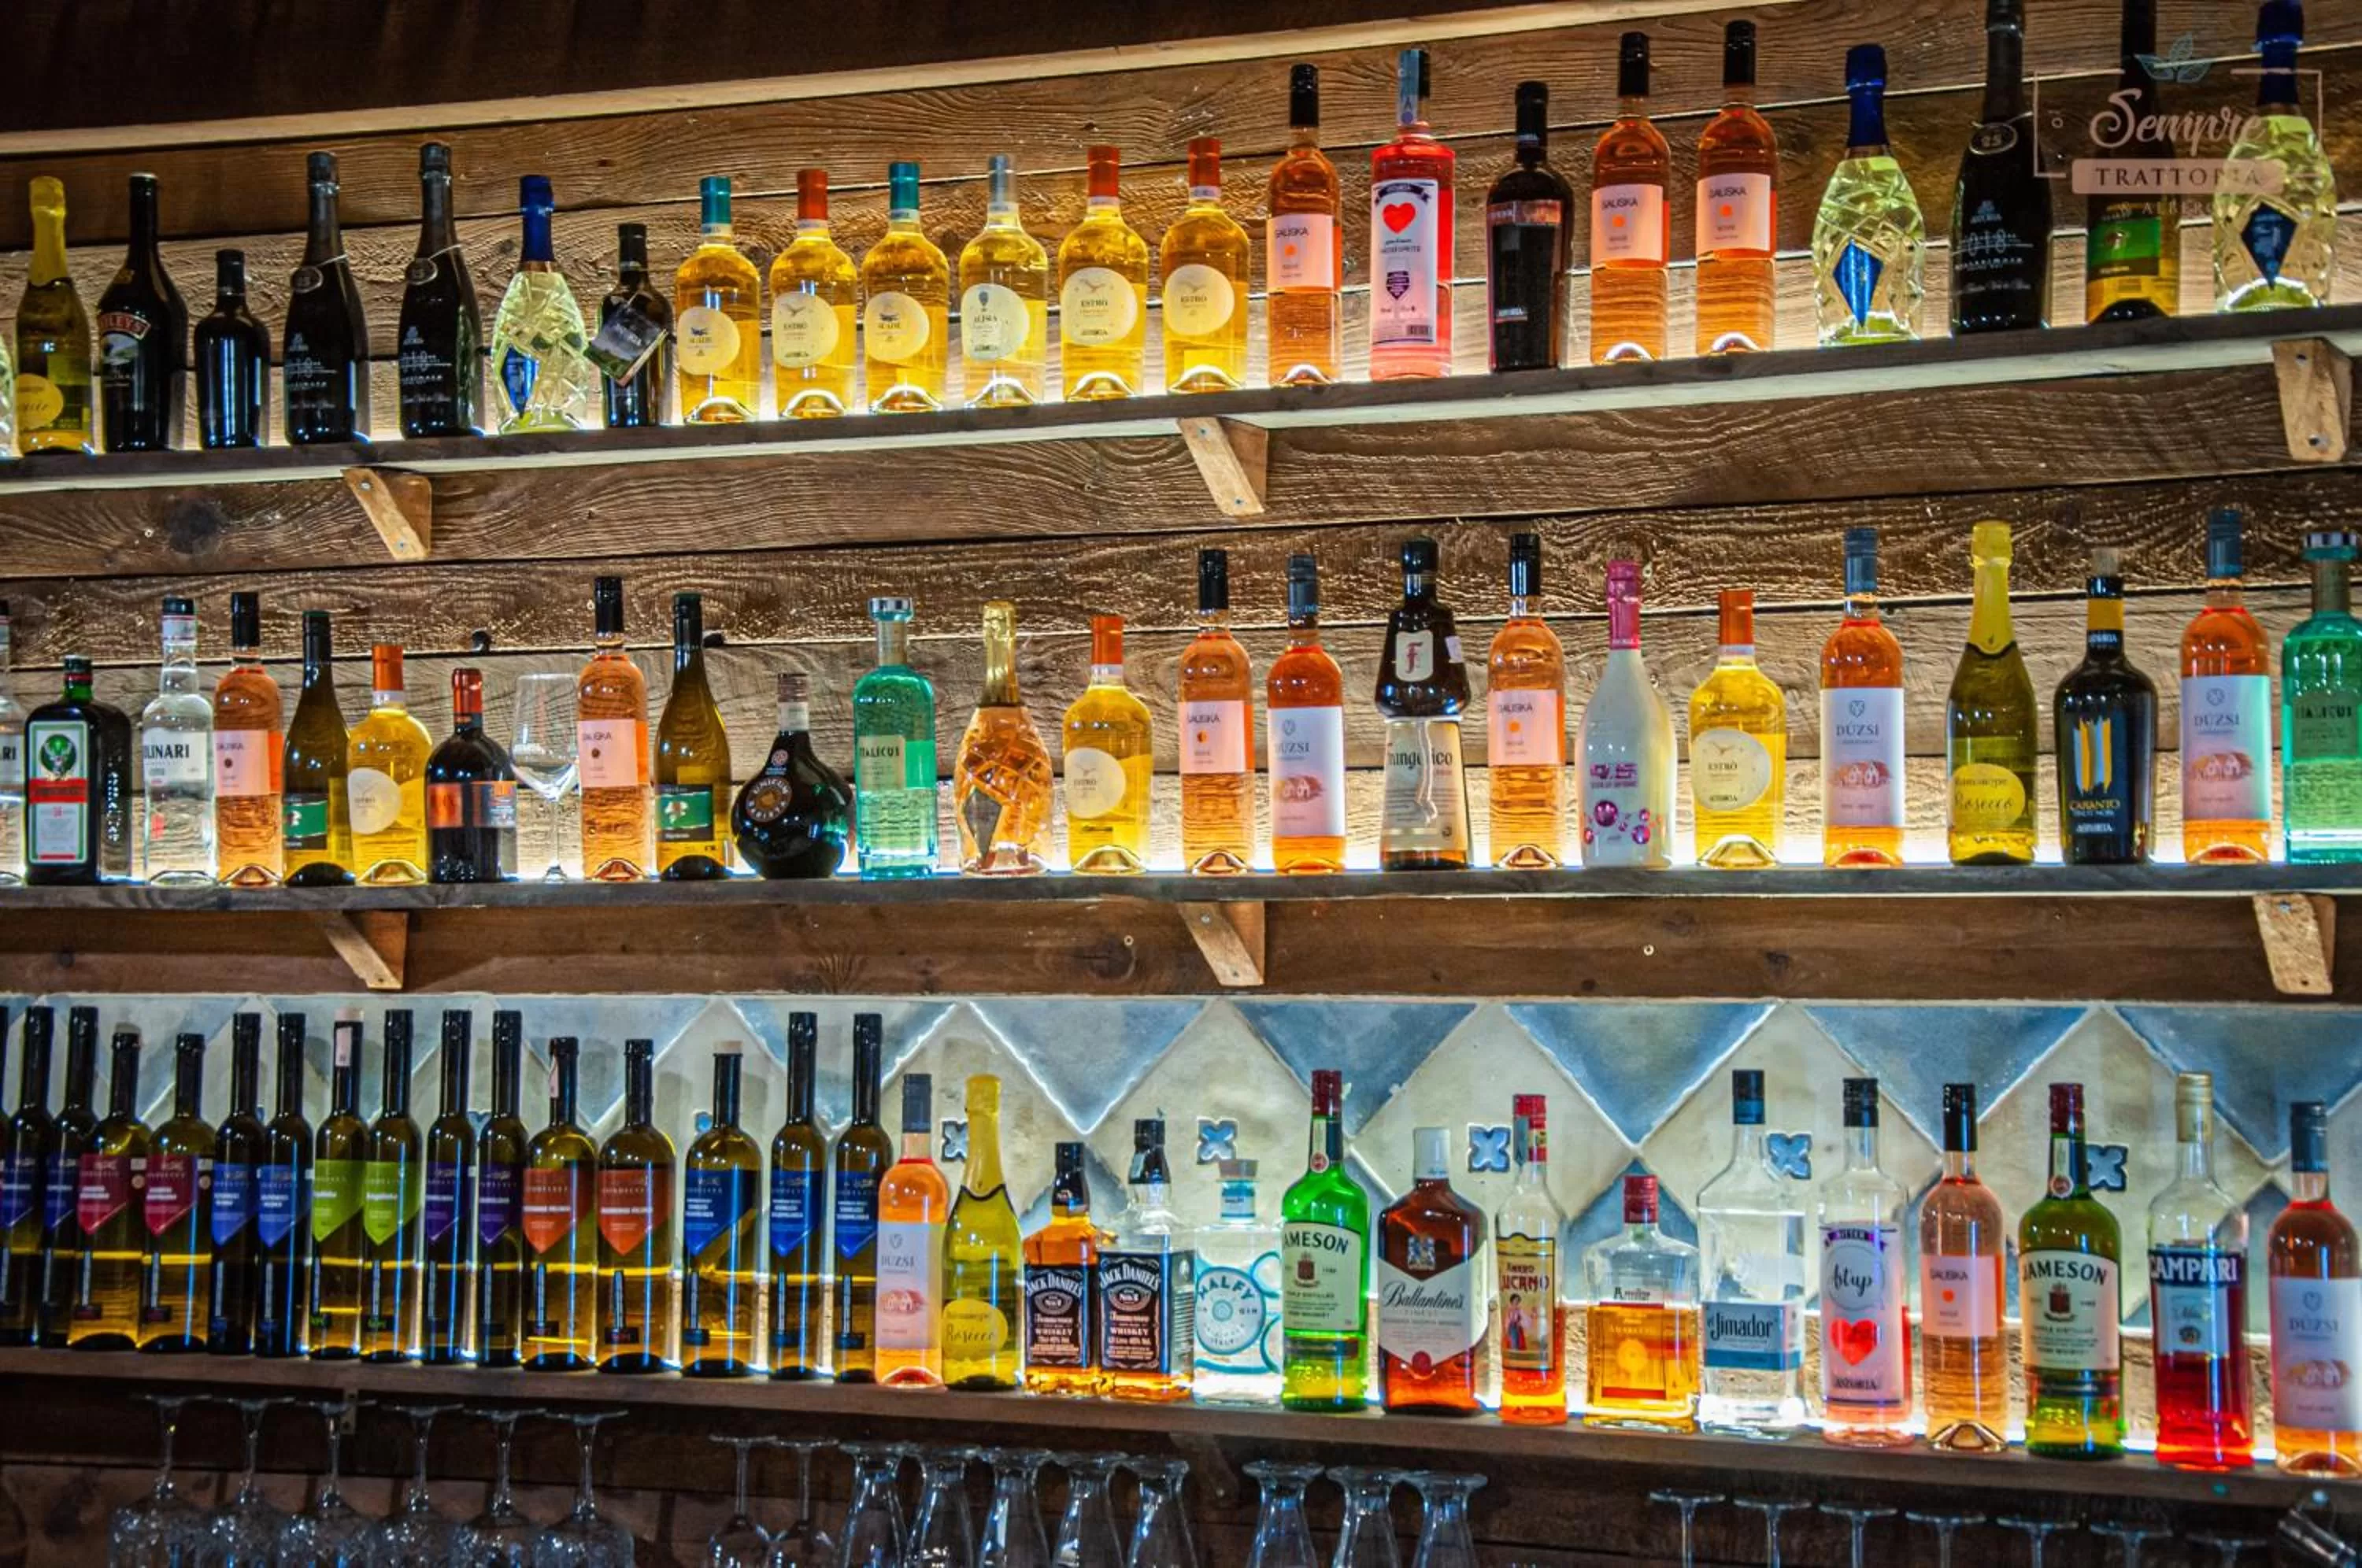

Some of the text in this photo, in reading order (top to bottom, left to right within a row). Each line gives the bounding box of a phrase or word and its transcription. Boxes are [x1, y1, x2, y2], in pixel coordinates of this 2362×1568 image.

[753, 778, 791, 795] UNICUM
[1284, 1230, 1349, 1256] AMESON
[1100, 1267, 1121, 1291] JACK
[2023, 1259, 2108, 1285] JAMESON
[2150, 1256, 2238, 1281] CAMPARI
[1026, 1278, 1048, 1298] JACK
[1383, 1280, 1465, 1310] Ballantine's
[1109, 1327, 1149, 1336] WHISKEY
[1709, 1311, 1773, 1341] Jimador
